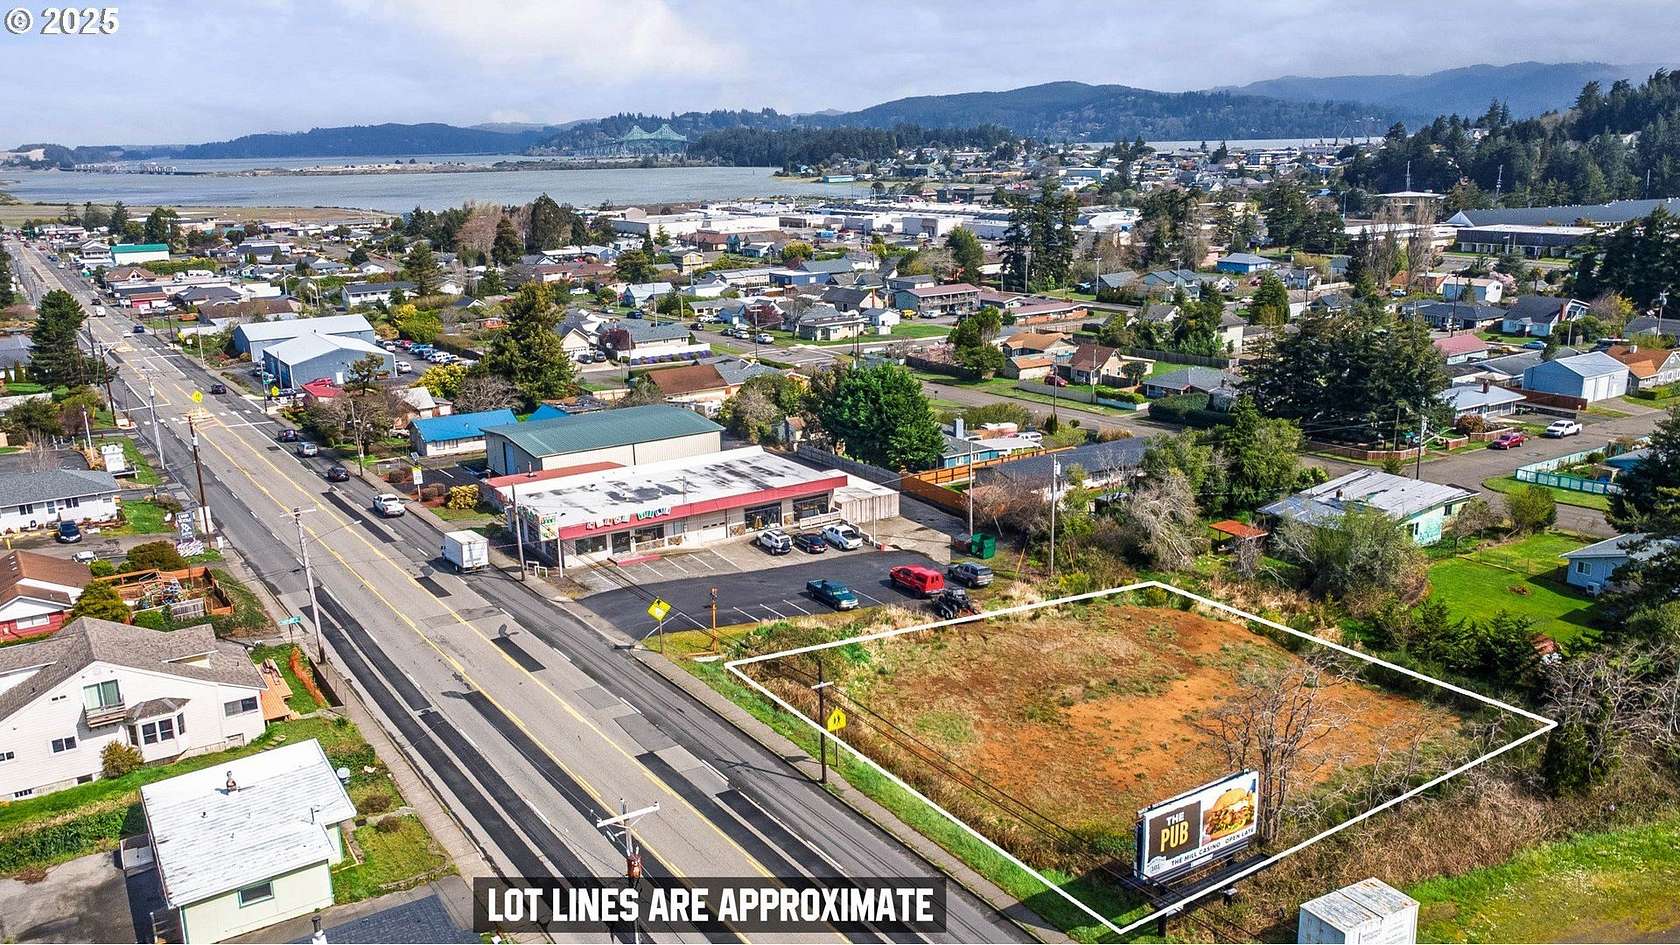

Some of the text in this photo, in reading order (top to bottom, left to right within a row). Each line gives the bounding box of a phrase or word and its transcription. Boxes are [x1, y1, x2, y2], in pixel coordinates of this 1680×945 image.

[1166, 812, 1185, 825] THE
[1160, 821, 1189, 851] PUB
[1171, 858, 1183, 866] THE
[1184, 852, 1198, 861] MILL
[1199, 842, 1221, 855] CASINO
[1225, 834, 1241, 844] OPEN
[1241, 828, 1254, 837] LATE
